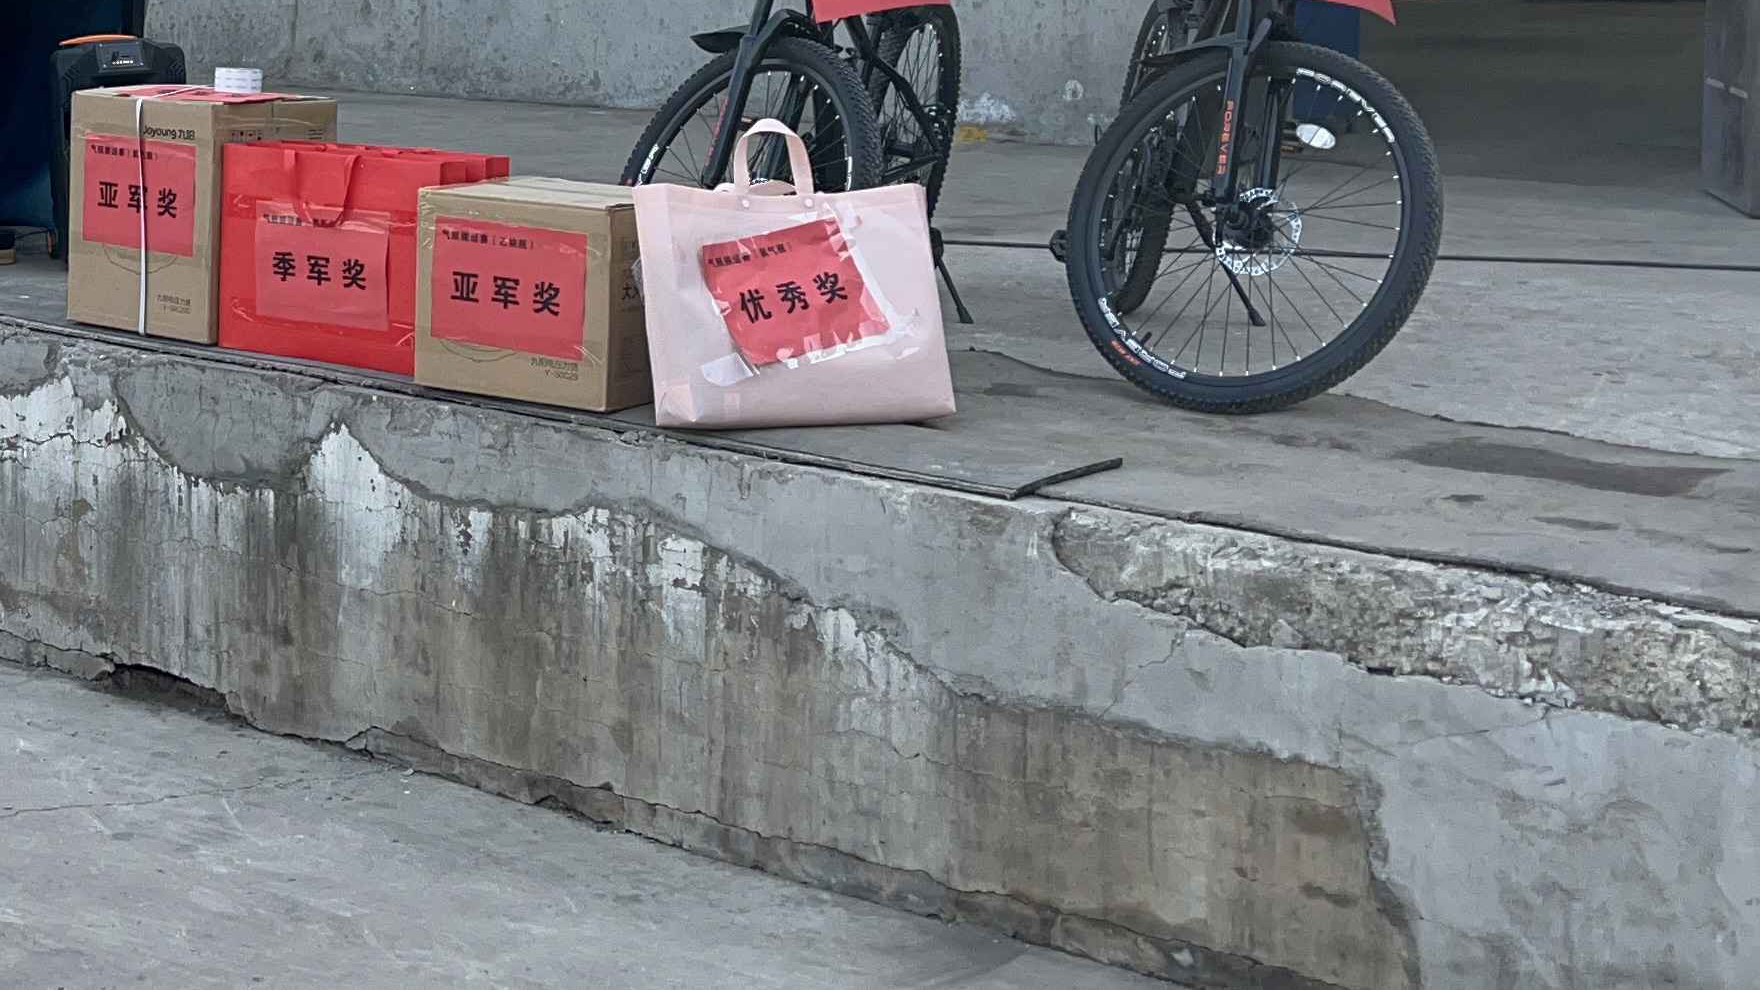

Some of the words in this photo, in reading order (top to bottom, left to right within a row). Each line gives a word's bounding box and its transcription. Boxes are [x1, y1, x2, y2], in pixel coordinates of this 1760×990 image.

[97, 180, 178, 218] 亚军奖
[272, 251, 367, 291] 季军奖
[450, 270, 561, 316] 亚军奖
[739, 271, 849, 324] 优秀奖
